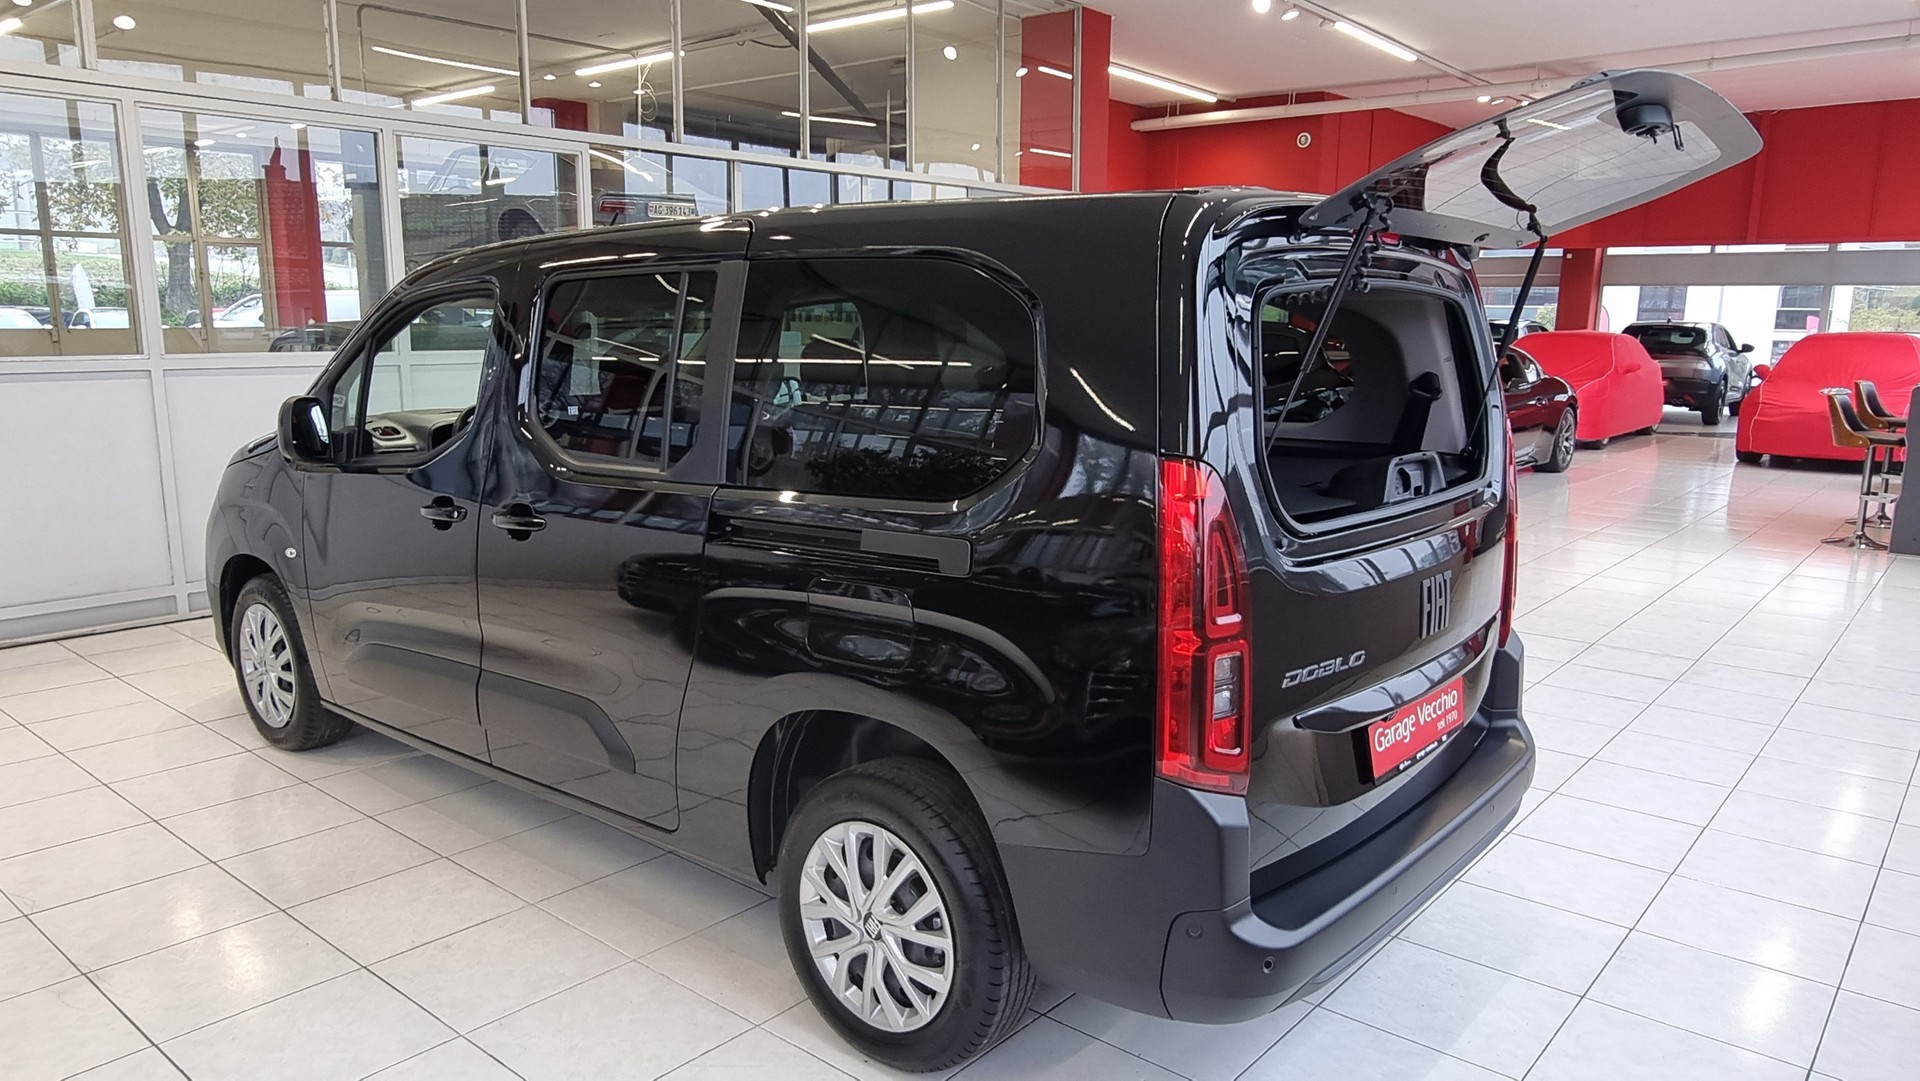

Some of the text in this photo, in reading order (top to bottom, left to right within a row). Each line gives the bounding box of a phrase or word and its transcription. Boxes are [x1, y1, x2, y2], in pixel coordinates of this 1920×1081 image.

[1421, 570, 1452, 639] FIAT
[1281, 650, 1366, 689] DOBLO
[1374, 714, 1416, 752] Garage
[1416, 688, 1458, 726] Vecchio
[1445, 709, 1458, 725] 1970
